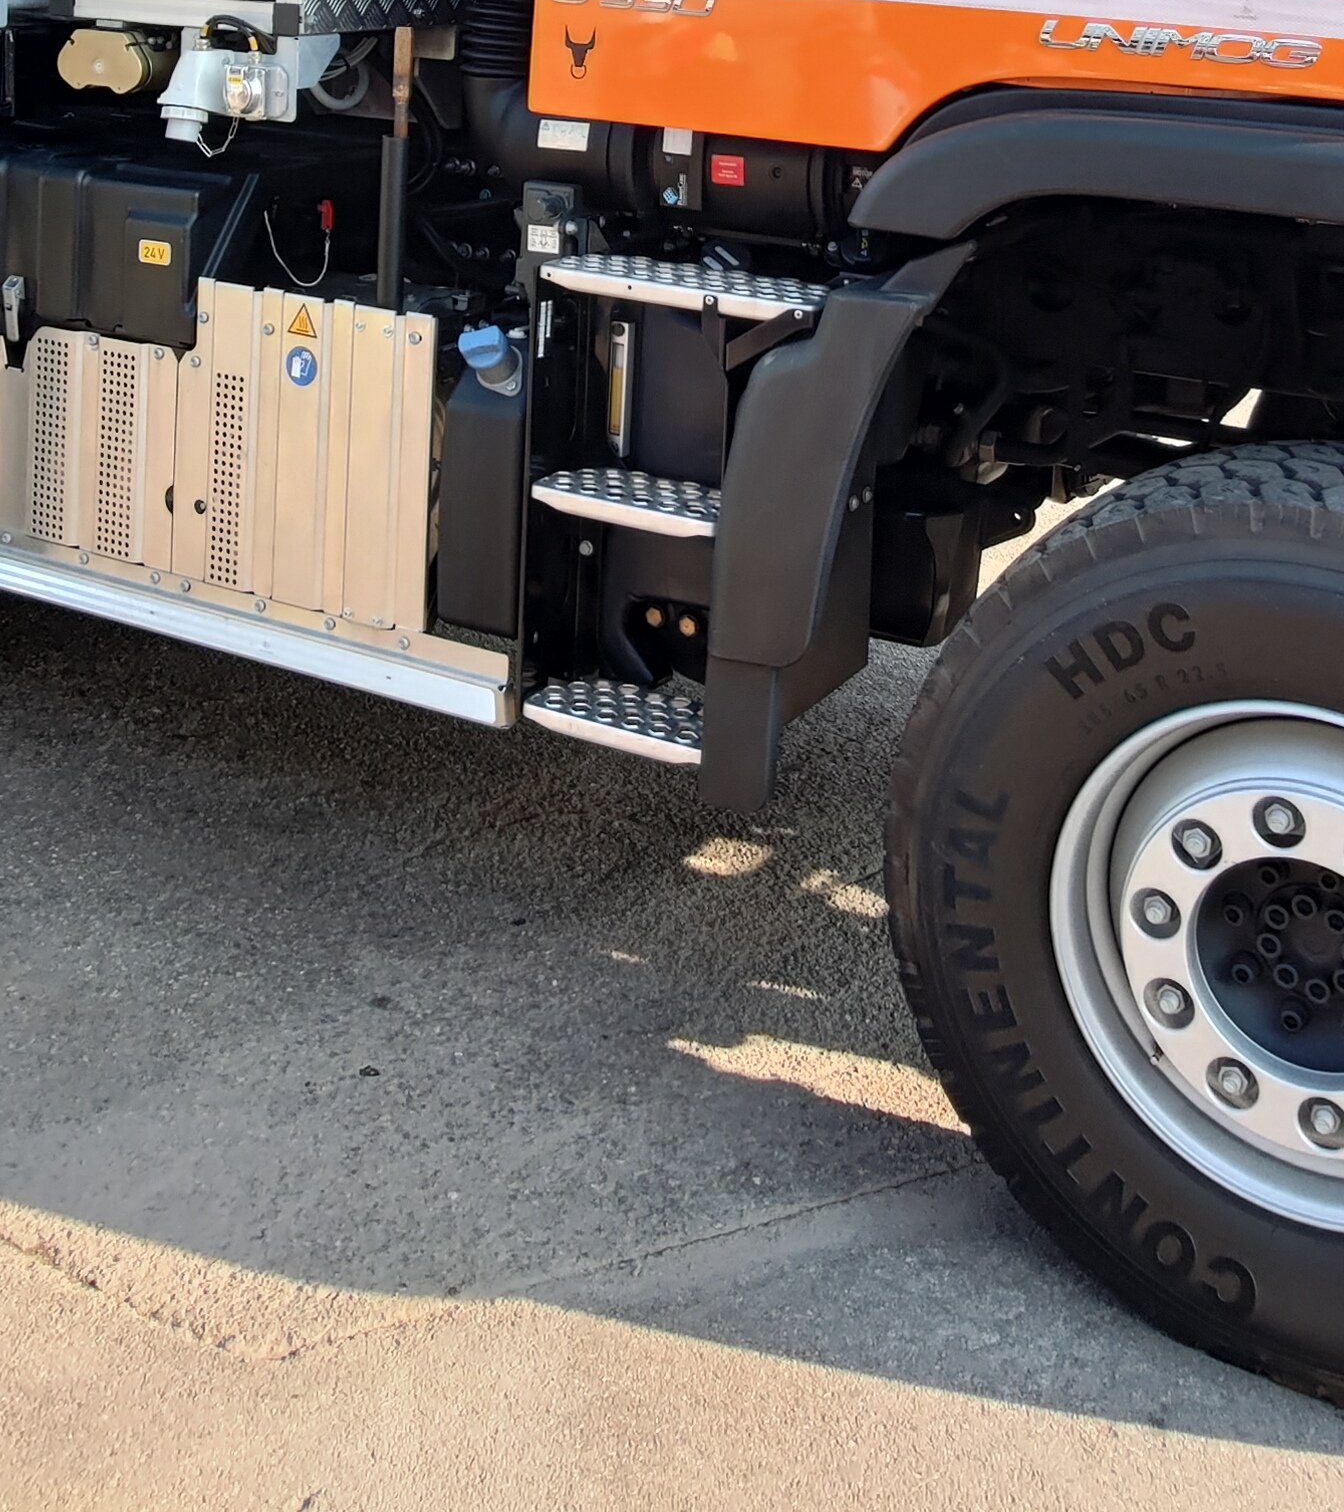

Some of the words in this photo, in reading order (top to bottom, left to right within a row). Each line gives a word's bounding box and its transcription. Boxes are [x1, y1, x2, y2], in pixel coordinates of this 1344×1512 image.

[1039, 19, 1323, 69] UNIMOG
[144, 246, 156, 259] 24
[157, 248, 165, 260] V
[1044, 602, 1196, 701] HDC
[943, 788, 1258, 1324] CONTINENTAL
